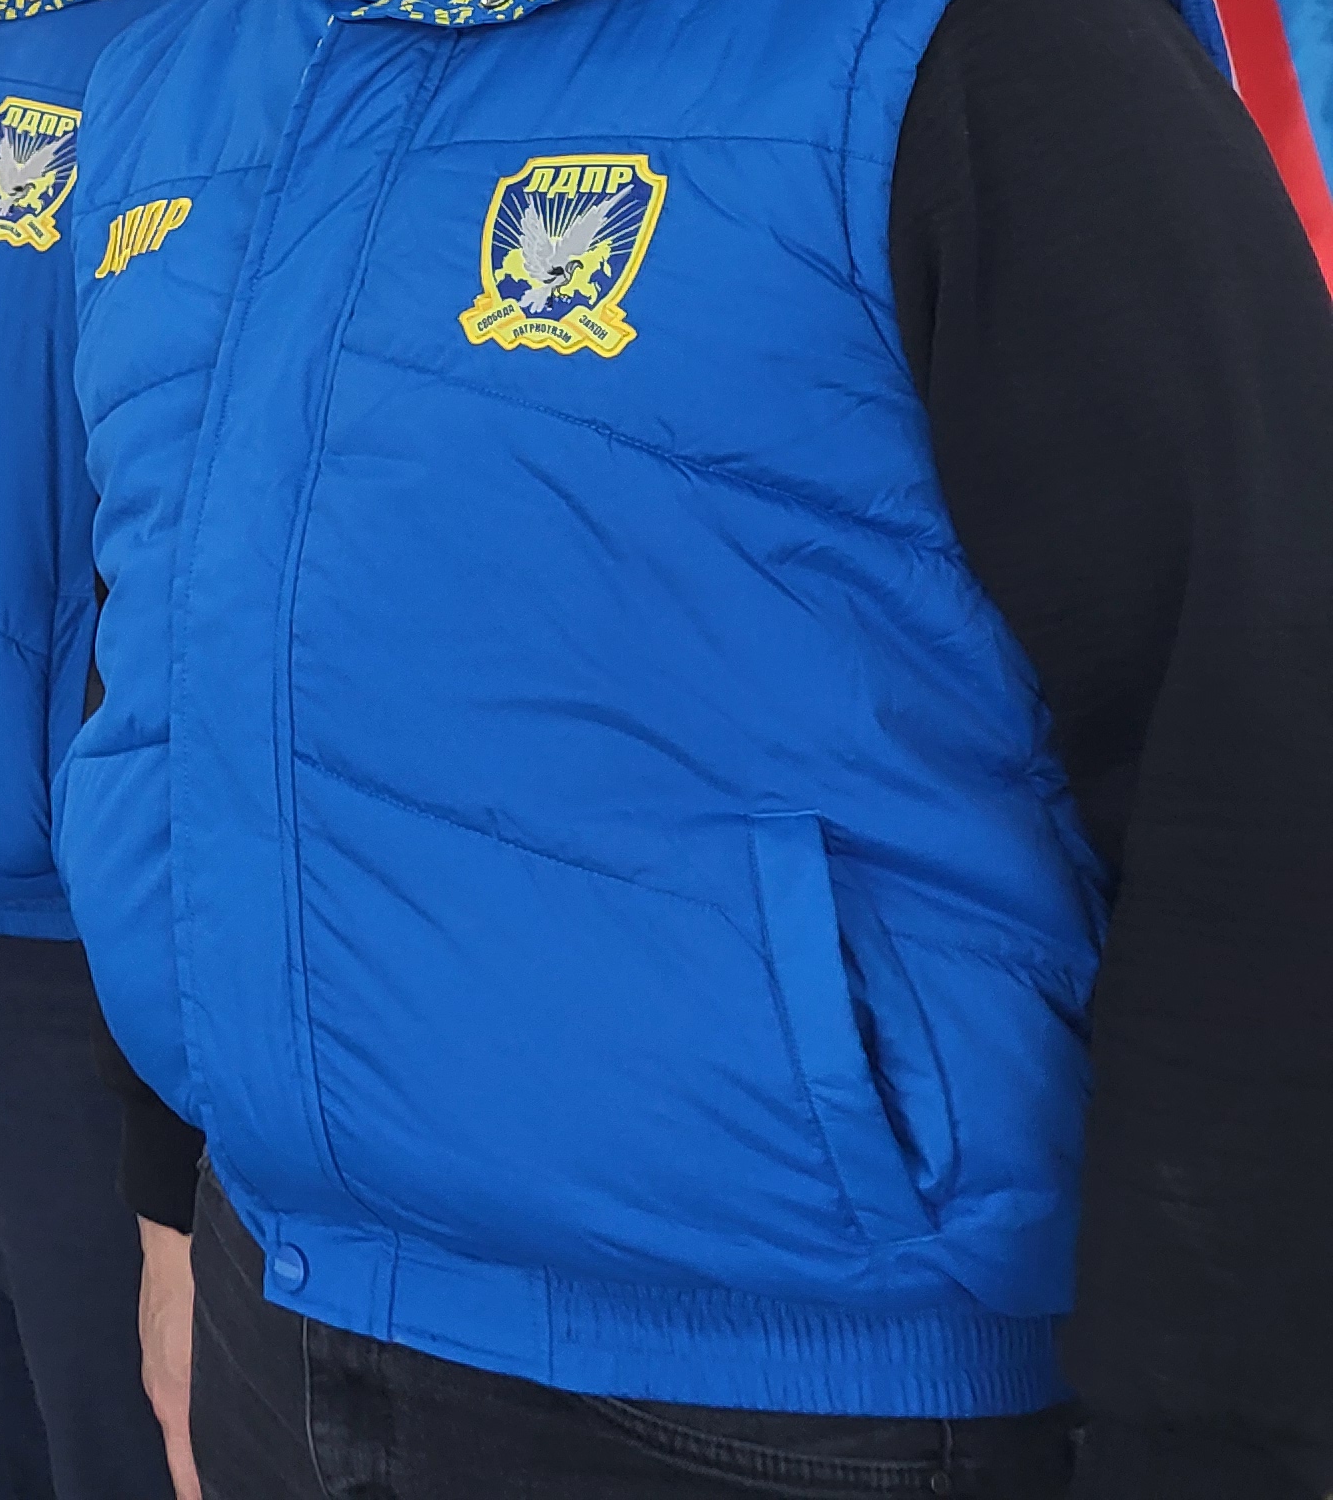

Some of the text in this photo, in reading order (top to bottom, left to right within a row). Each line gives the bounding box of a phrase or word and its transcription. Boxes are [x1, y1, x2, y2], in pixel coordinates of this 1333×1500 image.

[1, 106, 76, 136] ЛДПР
[523, 166, 634, 199] ЛДПР
[95, 197, 193, 279] ЛДПР
[476, 304, 515, 332] СВОБОДА
[578, 314, 608, 341] ЗАКОН
[513, 323, 572, 343] ПАТРИОТИЗМ
